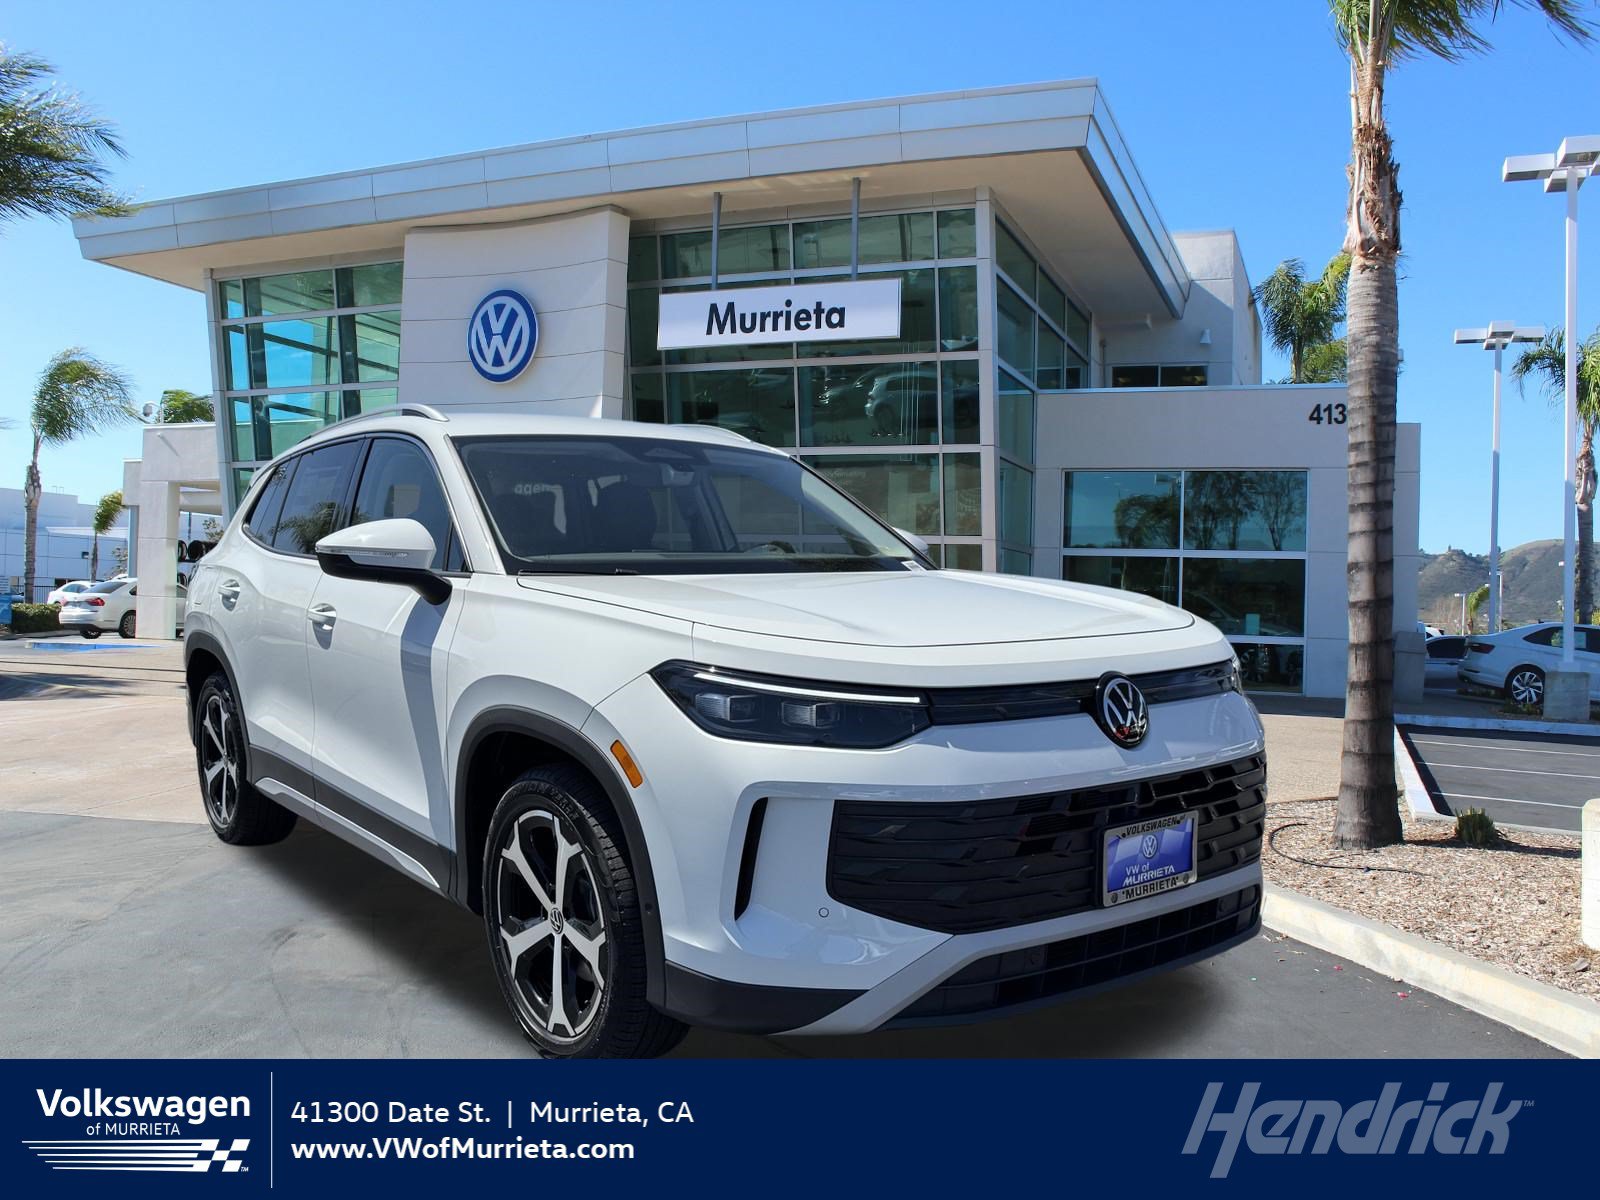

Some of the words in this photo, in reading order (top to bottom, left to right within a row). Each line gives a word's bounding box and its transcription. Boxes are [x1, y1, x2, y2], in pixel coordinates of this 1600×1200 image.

[706, 299, 846, 336] Murrieta
[1309, 404, 1347, 424] 413
[1126, 816, 1177, 835] VOLKSWAGEN
[1122, 865, 1175, 888] MURRIETA
[1125, 864, 1139, 876] VW
